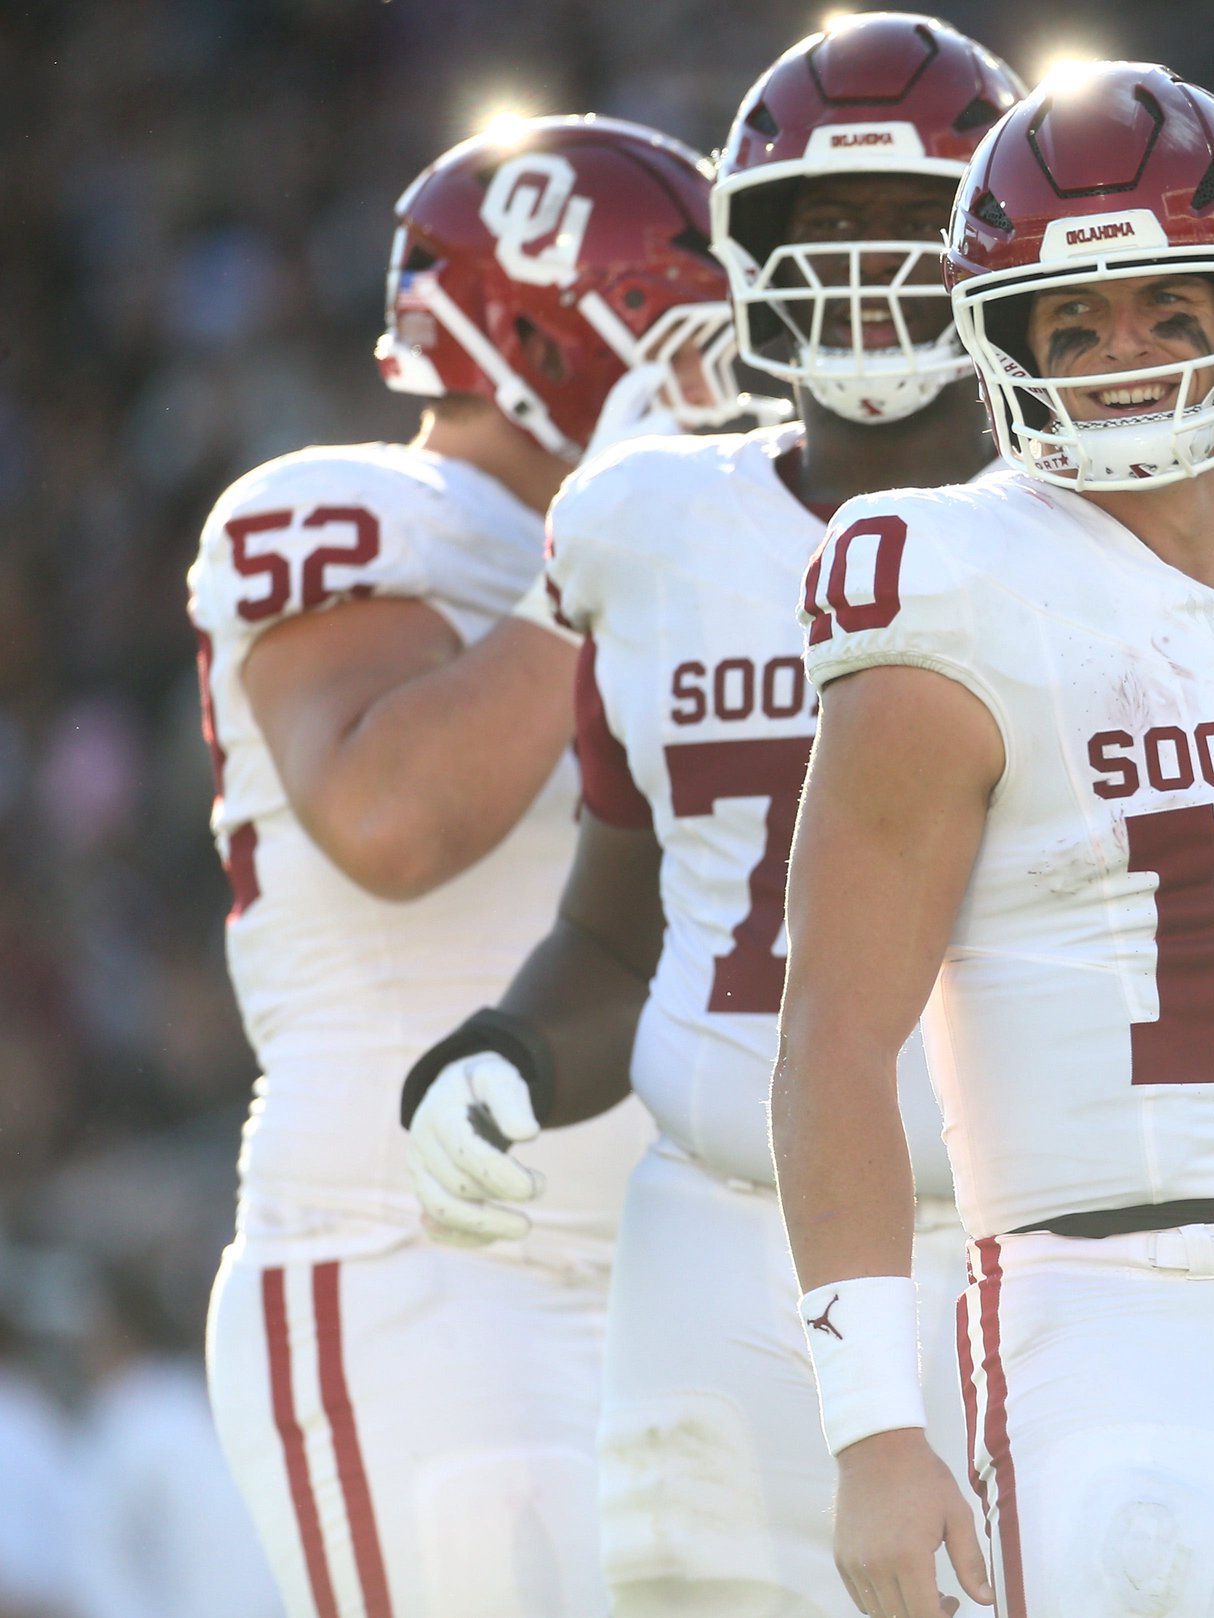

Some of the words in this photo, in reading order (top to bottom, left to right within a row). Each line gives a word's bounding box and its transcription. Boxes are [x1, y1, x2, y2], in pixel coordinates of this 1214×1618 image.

[1066, 222, 1135, 245] OKLAHOMA
[225, 507, 380, 623] 52
[804, 515, 908, 647] 10
